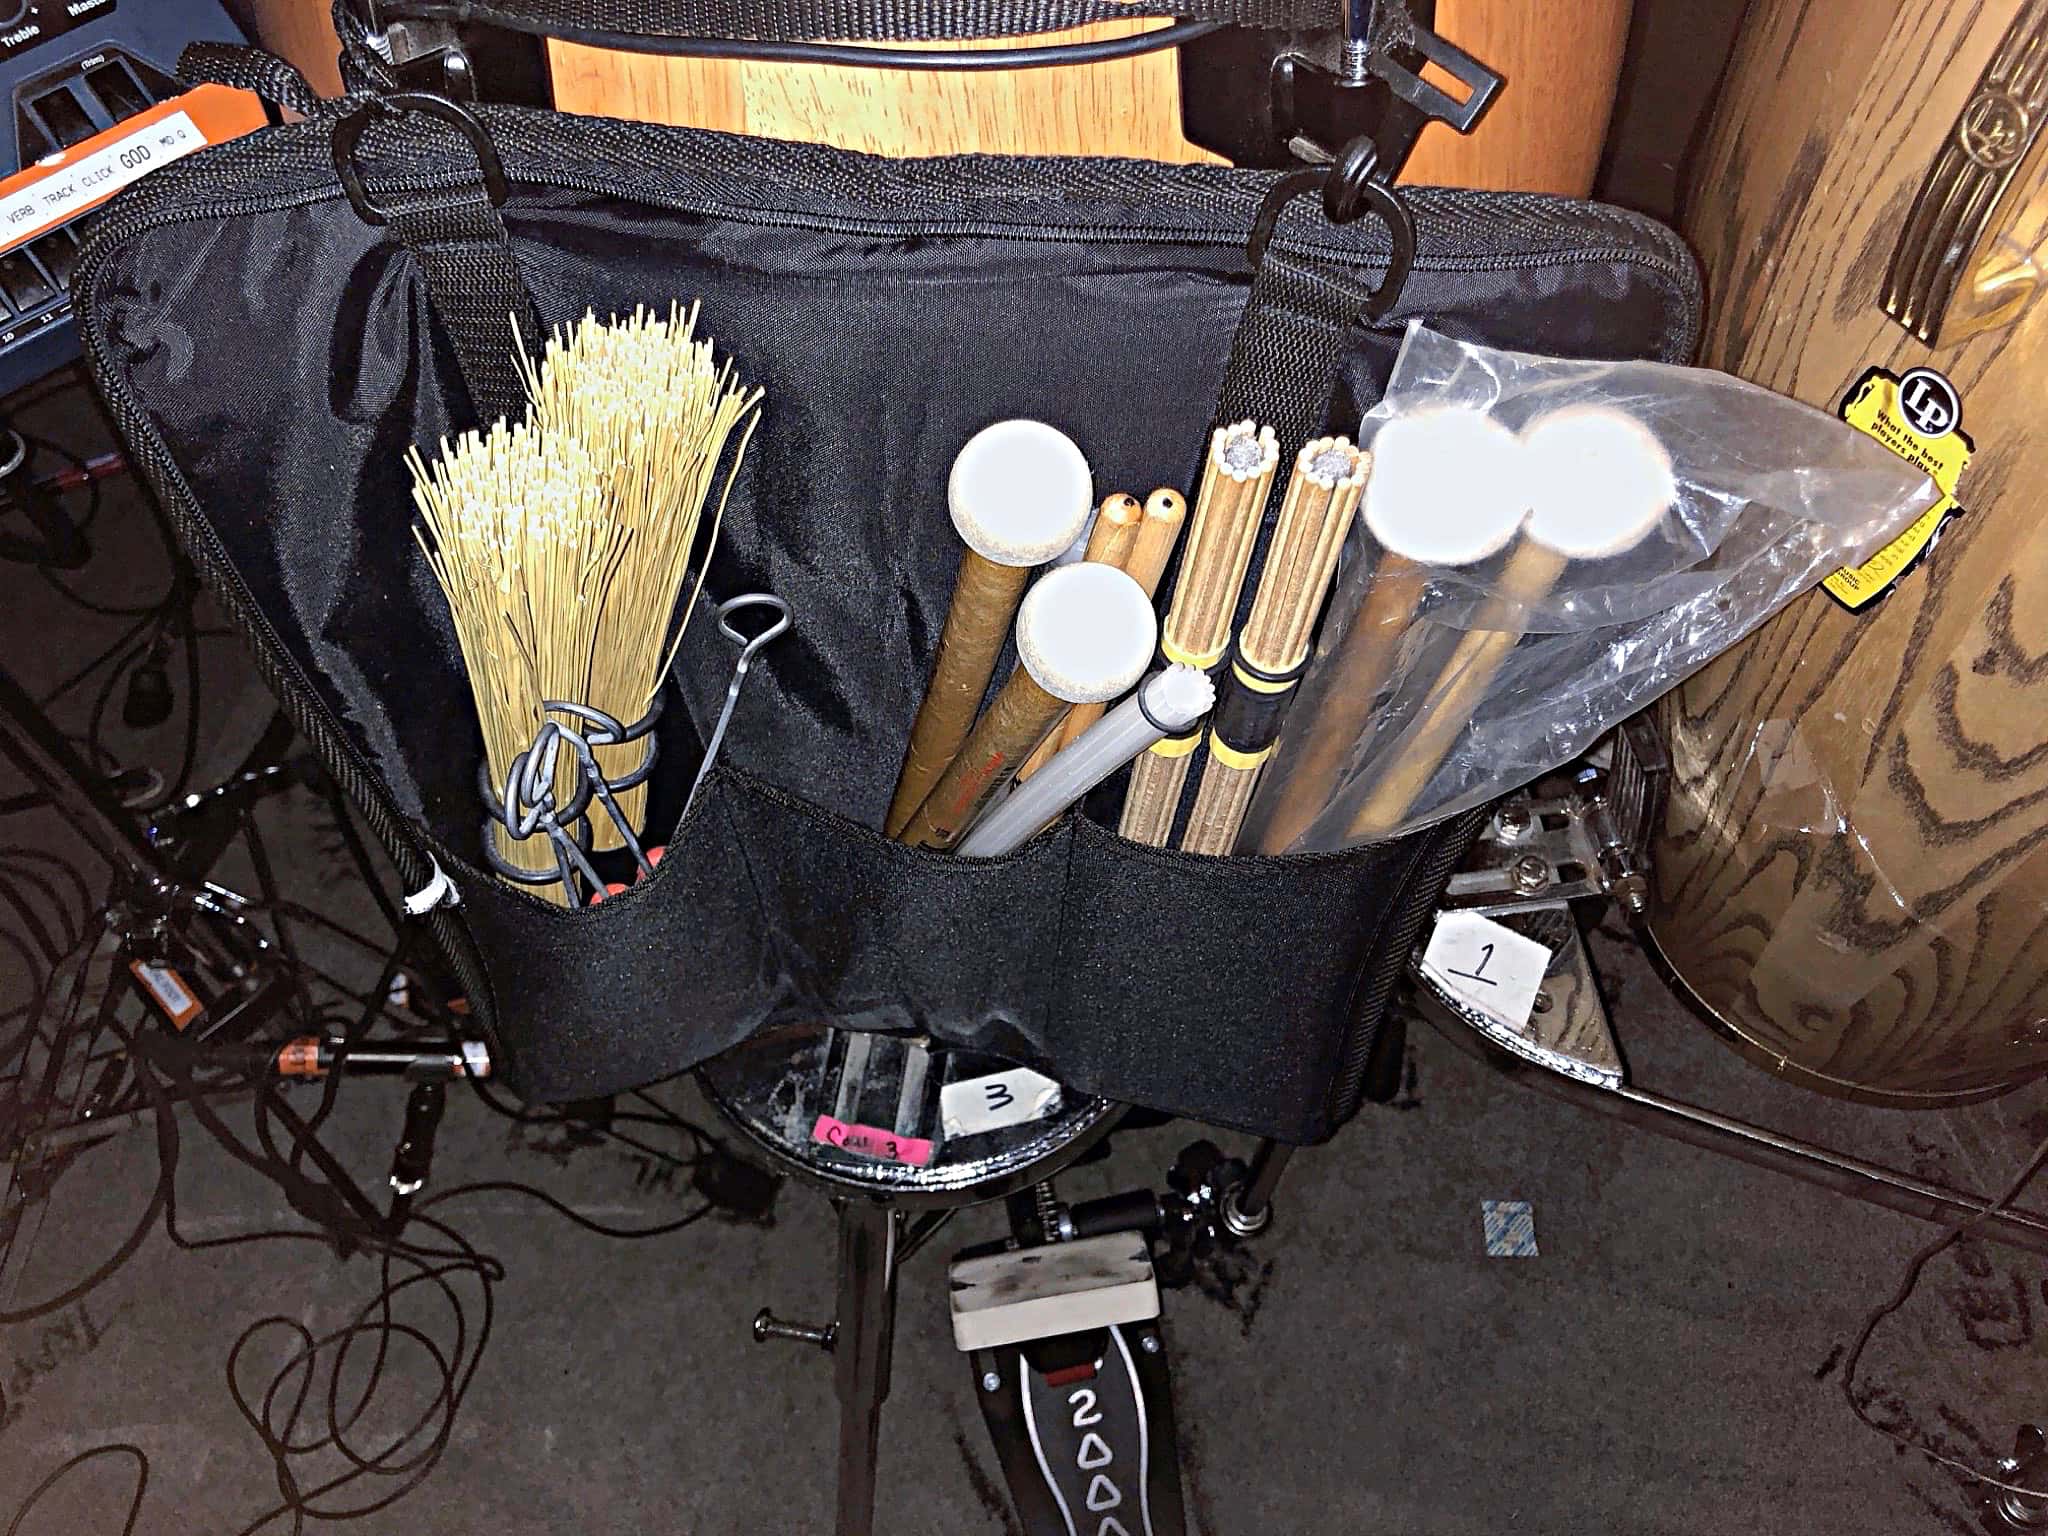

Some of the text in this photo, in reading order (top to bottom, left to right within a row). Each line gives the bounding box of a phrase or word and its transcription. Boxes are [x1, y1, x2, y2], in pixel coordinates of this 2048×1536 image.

[1, 26, 40, 48] Treble
[6, 205, 36, 225] VERB
[42, 183, 76, 208] TRACK
[81, 165, 113, 188] CLICK
[119, 144, 151, 169] GOD
[2, 332, 15, 343] 10
[1905, 379, 1949, 431] LP
[1871, 422, 1907, 454] players
[1877, 410, 1944, 470] What the best
[1840, 566, 1860, 585] USIC
